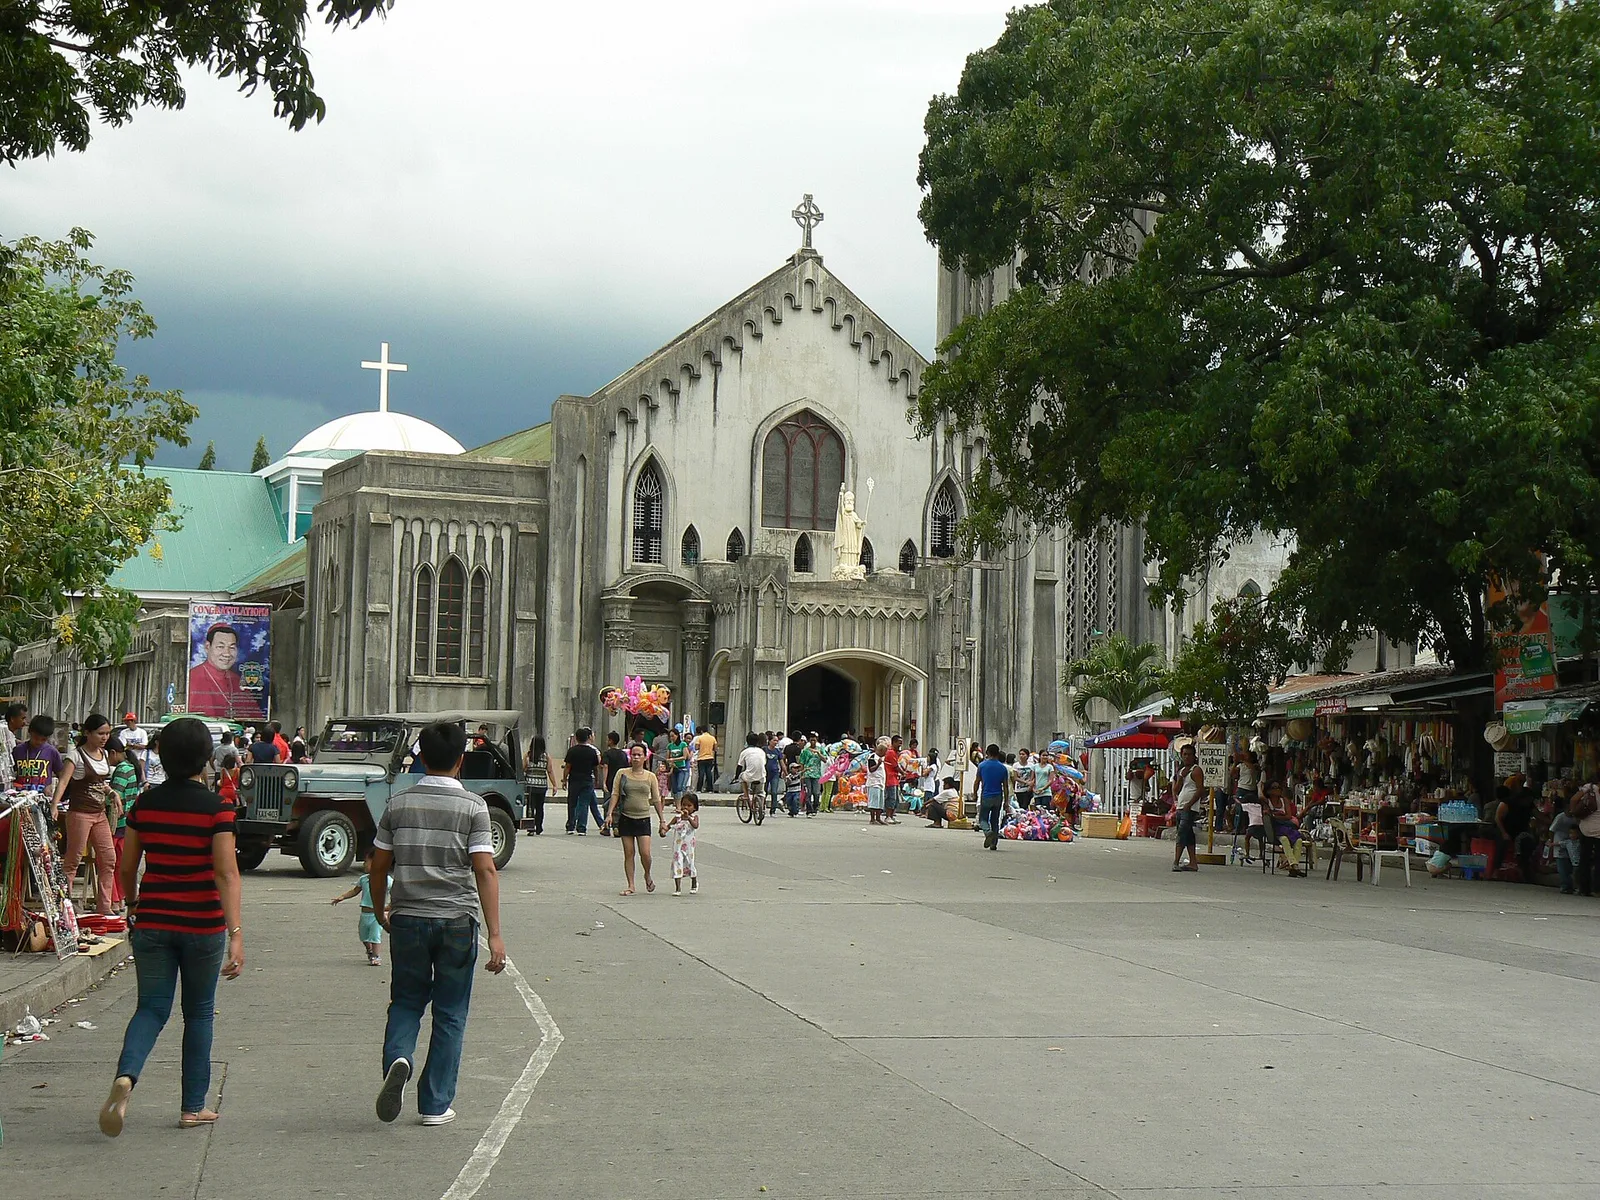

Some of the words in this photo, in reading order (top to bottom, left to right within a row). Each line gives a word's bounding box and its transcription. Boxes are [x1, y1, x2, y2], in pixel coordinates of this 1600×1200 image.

[1200, 748, 1226, 756] MOTORCYCLE
[17, 759, 50, 769] PARTY
[1202, 757, 1223, 765] PARKING
[18, 768, 39, 776] LIKE
[40, 768, 48, 778] A
[1205, 767, 1218, 775] AREA
